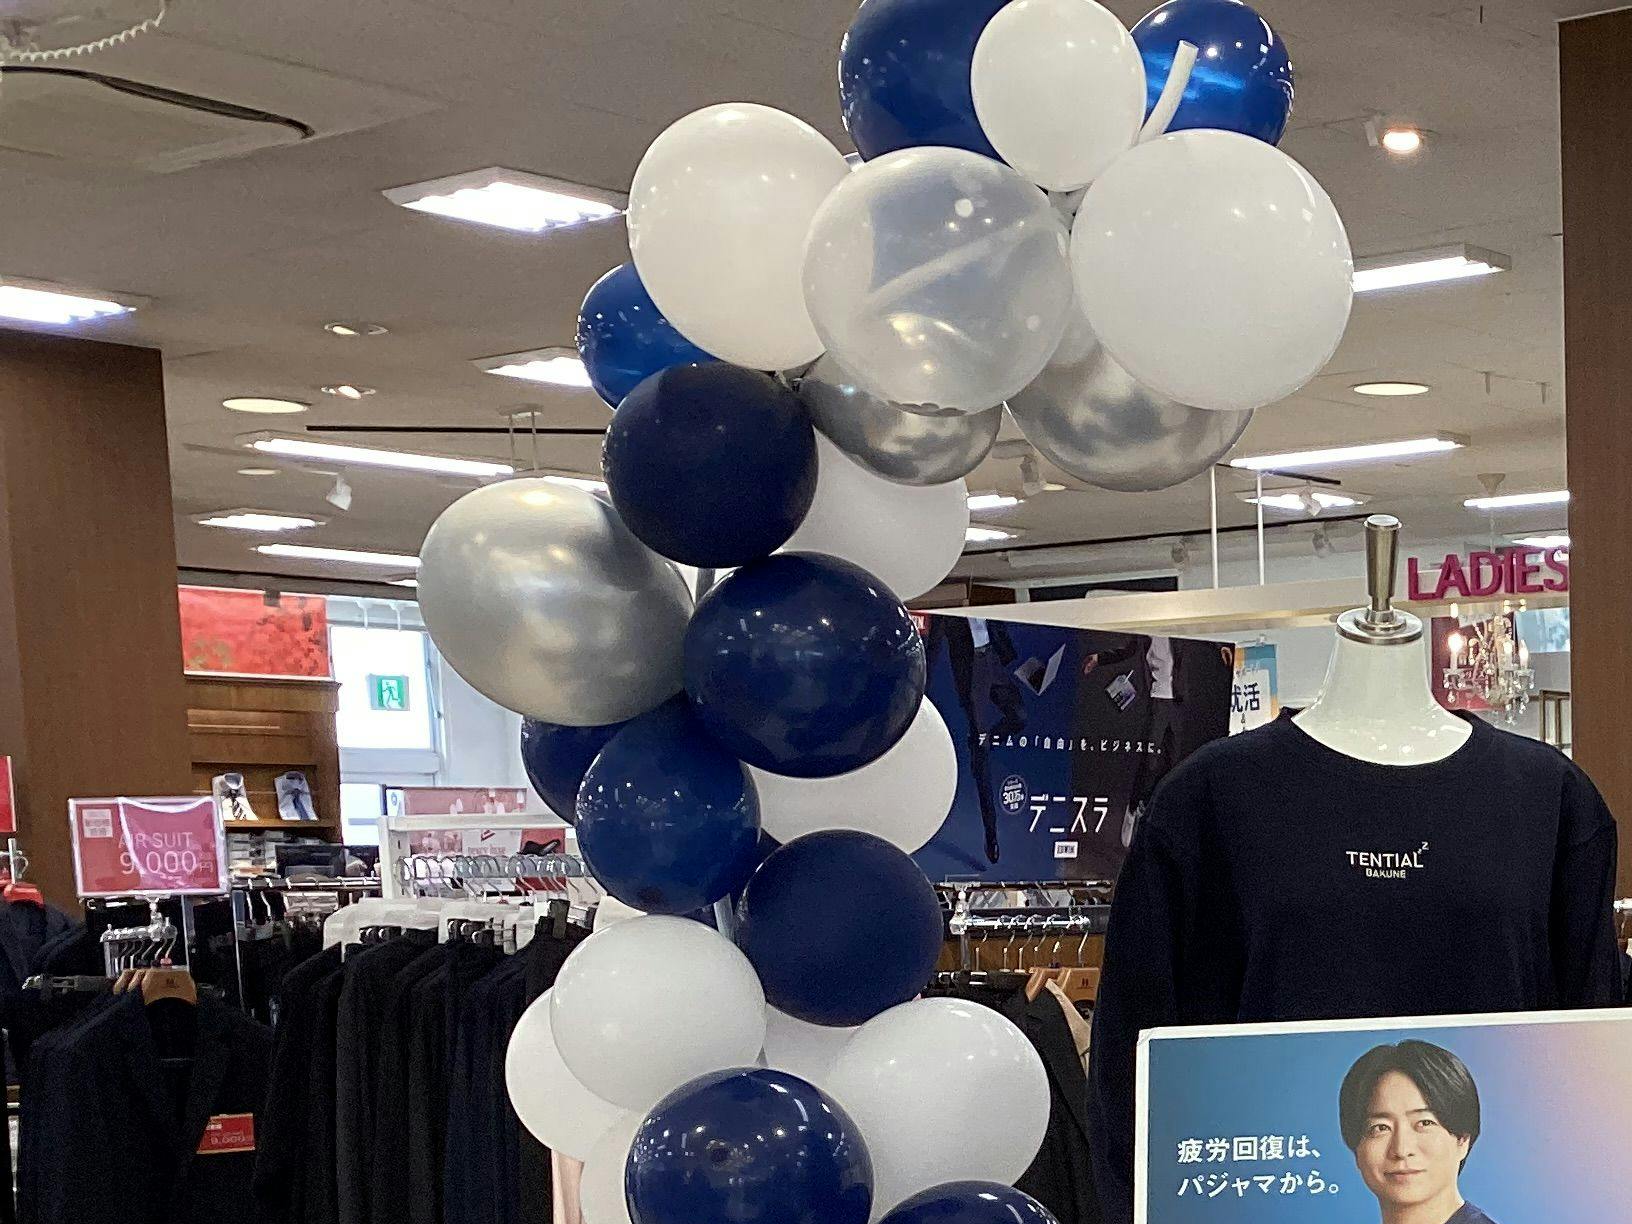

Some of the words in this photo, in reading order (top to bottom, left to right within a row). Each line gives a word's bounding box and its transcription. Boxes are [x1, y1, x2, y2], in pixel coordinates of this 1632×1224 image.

[1407, 545, 1569, 600] LADIES
[1029, 794, 1108, 832] デニスラ
[152, 832, 192, 848] SUIT
[1345, 851, 1424, 868] TENTIAL
[1365, 868, 1406, 878] BAKUNE
[1177, 1134, 1322, 1164] 疲労回復は、
[1177, 1170, 1340, 1198] パジャマから。
